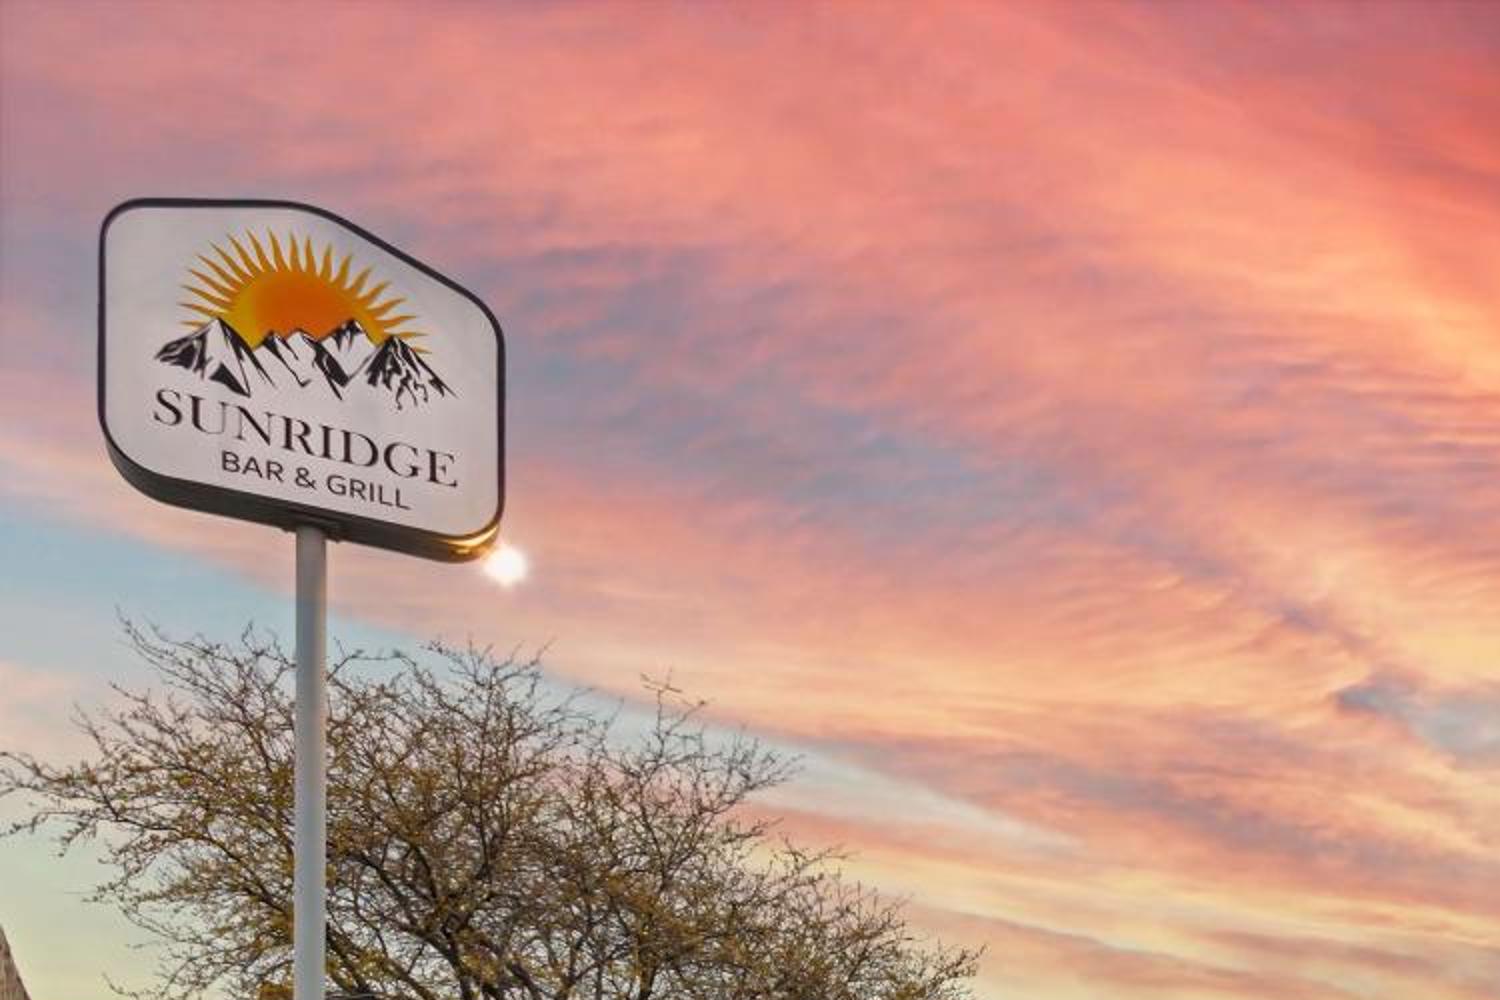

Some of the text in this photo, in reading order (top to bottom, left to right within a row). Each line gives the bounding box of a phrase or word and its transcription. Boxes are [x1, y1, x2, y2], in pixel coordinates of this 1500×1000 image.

[153, 388, 459, 488] SUNRIDGE
[221, 451, 412, 511] BAR & GRILL
